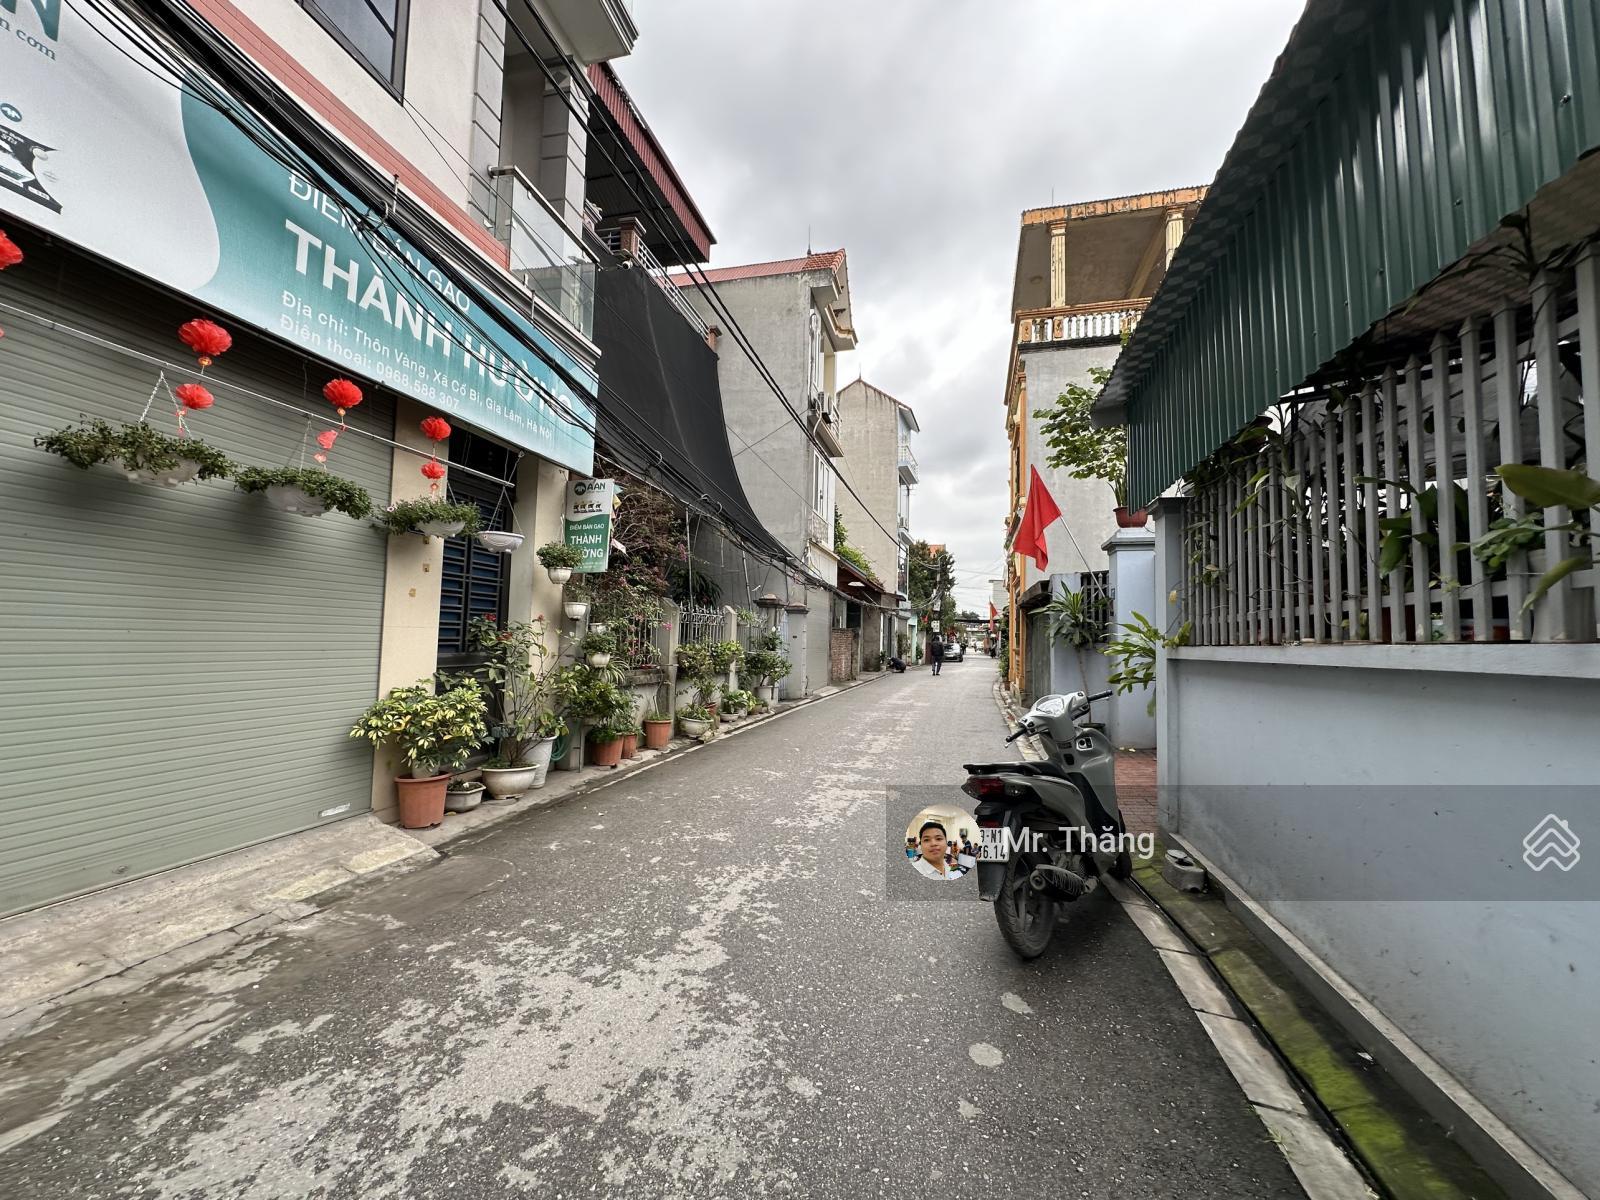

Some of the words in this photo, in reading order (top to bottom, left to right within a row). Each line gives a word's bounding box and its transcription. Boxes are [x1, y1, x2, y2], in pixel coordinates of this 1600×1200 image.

[285, 219, 452, 358] THÀNH
[281, 290, 312, 319] Địa
[353, 326, 390, 358] Thôn
[395, 348, 430, 380] Vàng,
[432, 368, 448, 388] Xã
[485, 397, 501, 415] Gia
[571, 533, 602, 545] THÀNH
[582, 546, 604, 558] ỜNG
